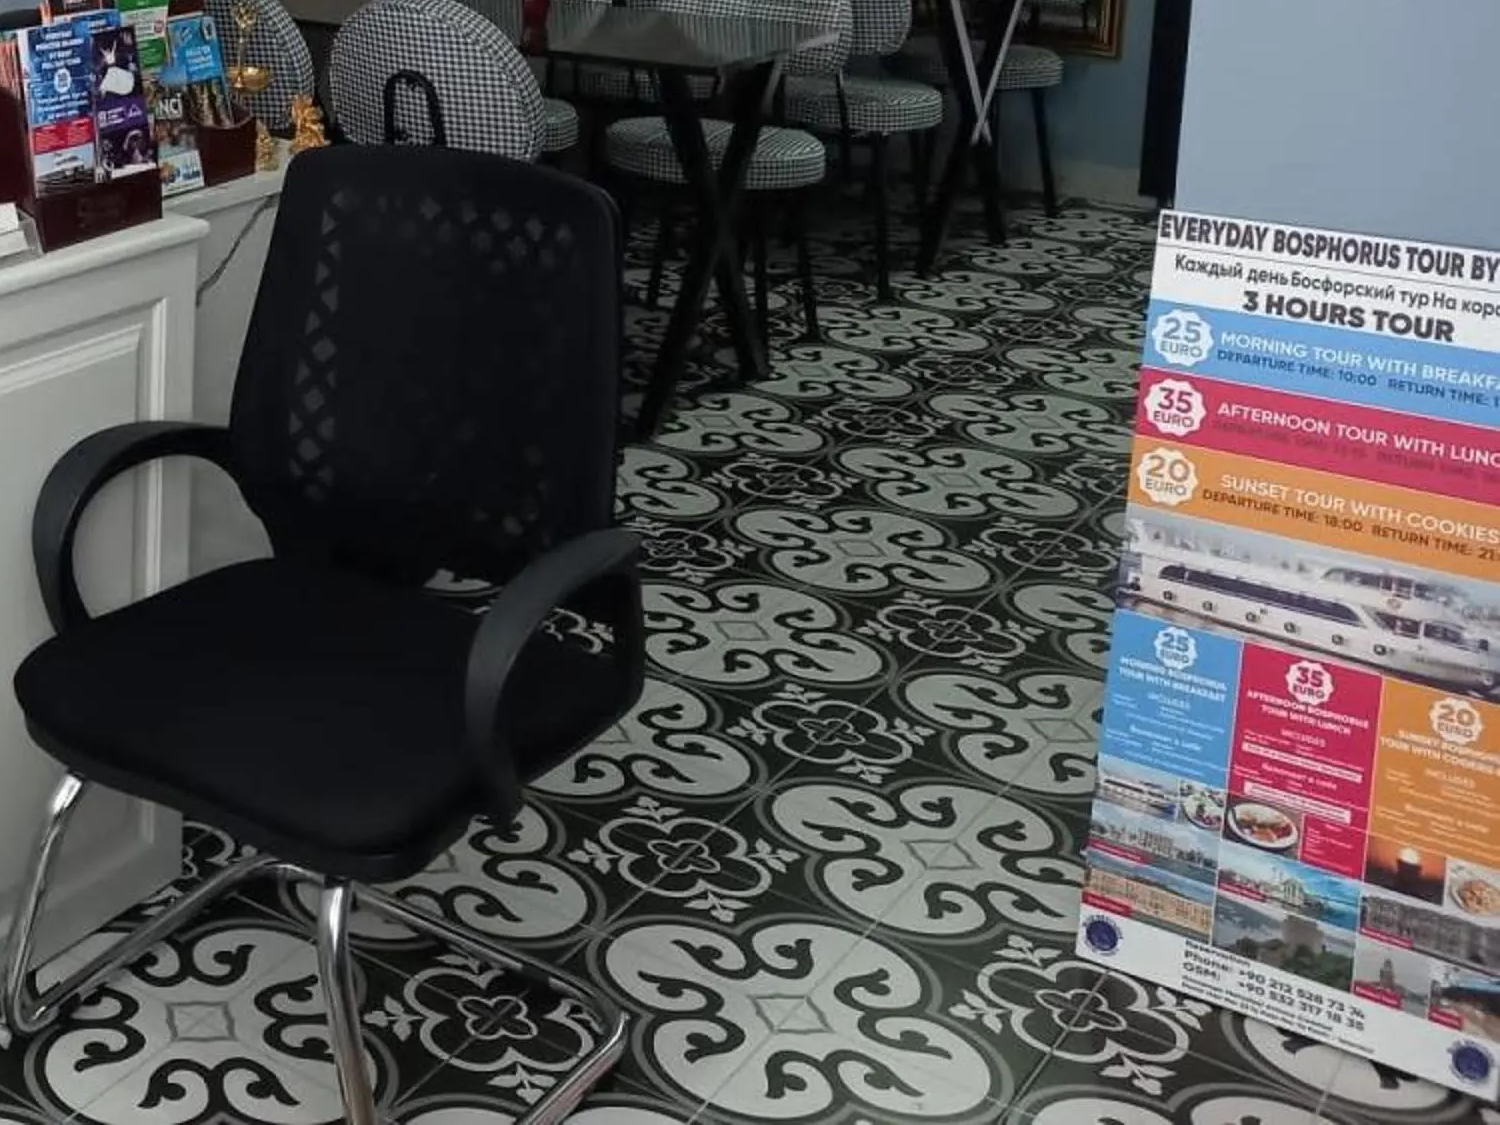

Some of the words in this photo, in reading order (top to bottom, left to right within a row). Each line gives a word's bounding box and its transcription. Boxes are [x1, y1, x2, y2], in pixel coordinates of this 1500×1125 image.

[1159, 214, 1269, 251] EVERYDAY
[1272, 229, 1401, 270] BOSPHORUS
[1405, 246, 1465, 278] TOUR
[1470, 255, 1500, 283] BY
[1175, 254, 1243, 279] Каждый
[1246, 267, 1289, 287] день
[1291, 271, 1396, 301] Босфорский
[1399, 290, 1429, 309] тур
[1432, 291, 1457, 310] На
[1163, 318, 1201, 344] 25
[1243, 291, 1259, 312] 3
[1265, 294, 1365, 328] HOURS
[1372, 309, 1455, 342] TOUR
[1160, 341, 1203, 359] EURO
[1220, 331, 1309, 357] MORNING
[1312, 346, 1362, 367] TOUR
[1366, 354, 1417, 376] WITH
[1217, 348, 1296, 371] DEPARTURE
[1299, 361, 1335, 378] TIME:
[1338, 370, 1377, 387] 10:00
[1387, 378, 1445, 399] RETURN
[1449, 388, 1489, 405] TIME:
[1158, 386, 1193, 414] 35
[1153, 410, 1195, 428] EURO
[1217, 402, 1331, 436] AFTERNOON
[1336, 424, 1388, 447] TOUR
[1393, 433, 1445, 457] WITH
[1146, 454, 1190, 483] 20
[1145, 477, 1188, 496] EURO
[1202, 488, 1282, 513] DEPARTURE
[1284, 506, 1318, 522] TIME:
[1372, 525, 1430, 546] RETURN
[1434, 538, 1473, 556] TIME:
[1220, 474, 1292, 500] SUNSET
[1296, 489, 1346, 512] TOUR
[1350, 499, 1401, 524] WITH
[1406, 512, 1500, 544] COOKIES
[1162, 632, 1190, 652] 25
[1119, 666, 1145, 681] TOUR
[1146, 674, 1171, 688] WITH
[1172, 682, 1226, 703] BREAKFAST
[1292, 682, 1325, 700] EURO
[1296, 666, 1324, 688] 35
[1247, 688, 1307, 713] AFTERNOON
[1308, 703, 1369, 729] BOSPHORUS
[1261, 703, 1288, 719] TOUR
[1289, 712, 1316, 727] WITH
[1317, 720, 1351, 736] LUNCH
[1437, 704, 1477, 726] 20
[1437, 722, 1474, 738] EURO
[1379, 735, 1411, 752] TOUR
[1411, 744, 1441, 760] WITH
[1184, 949, 1232, 973] Phone:
[1238, 968, 1266, 985] +90
[1268, 977, 1293, 994] 212
